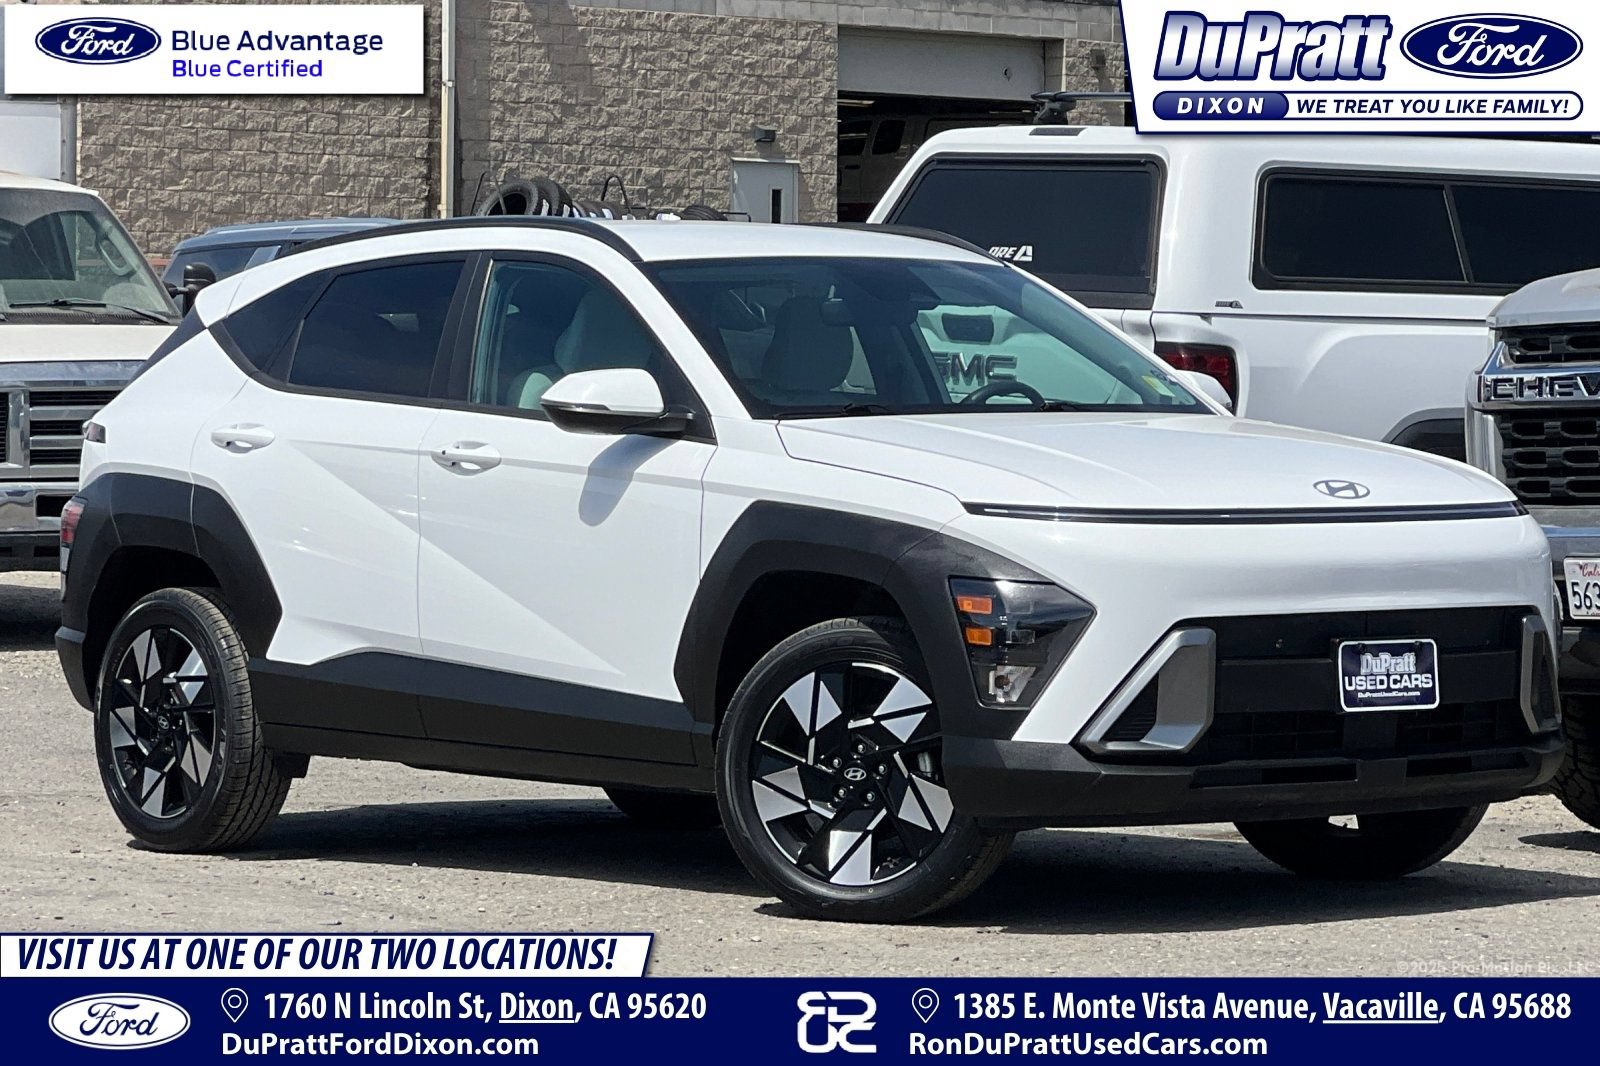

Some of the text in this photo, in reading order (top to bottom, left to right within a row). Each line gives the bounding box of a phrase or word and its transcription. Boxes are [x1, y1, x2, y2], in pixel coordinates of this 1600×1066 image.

[1360, 652, 1416, 675] DuPratt
[1344, 673, 1433, 691] USED CARS
